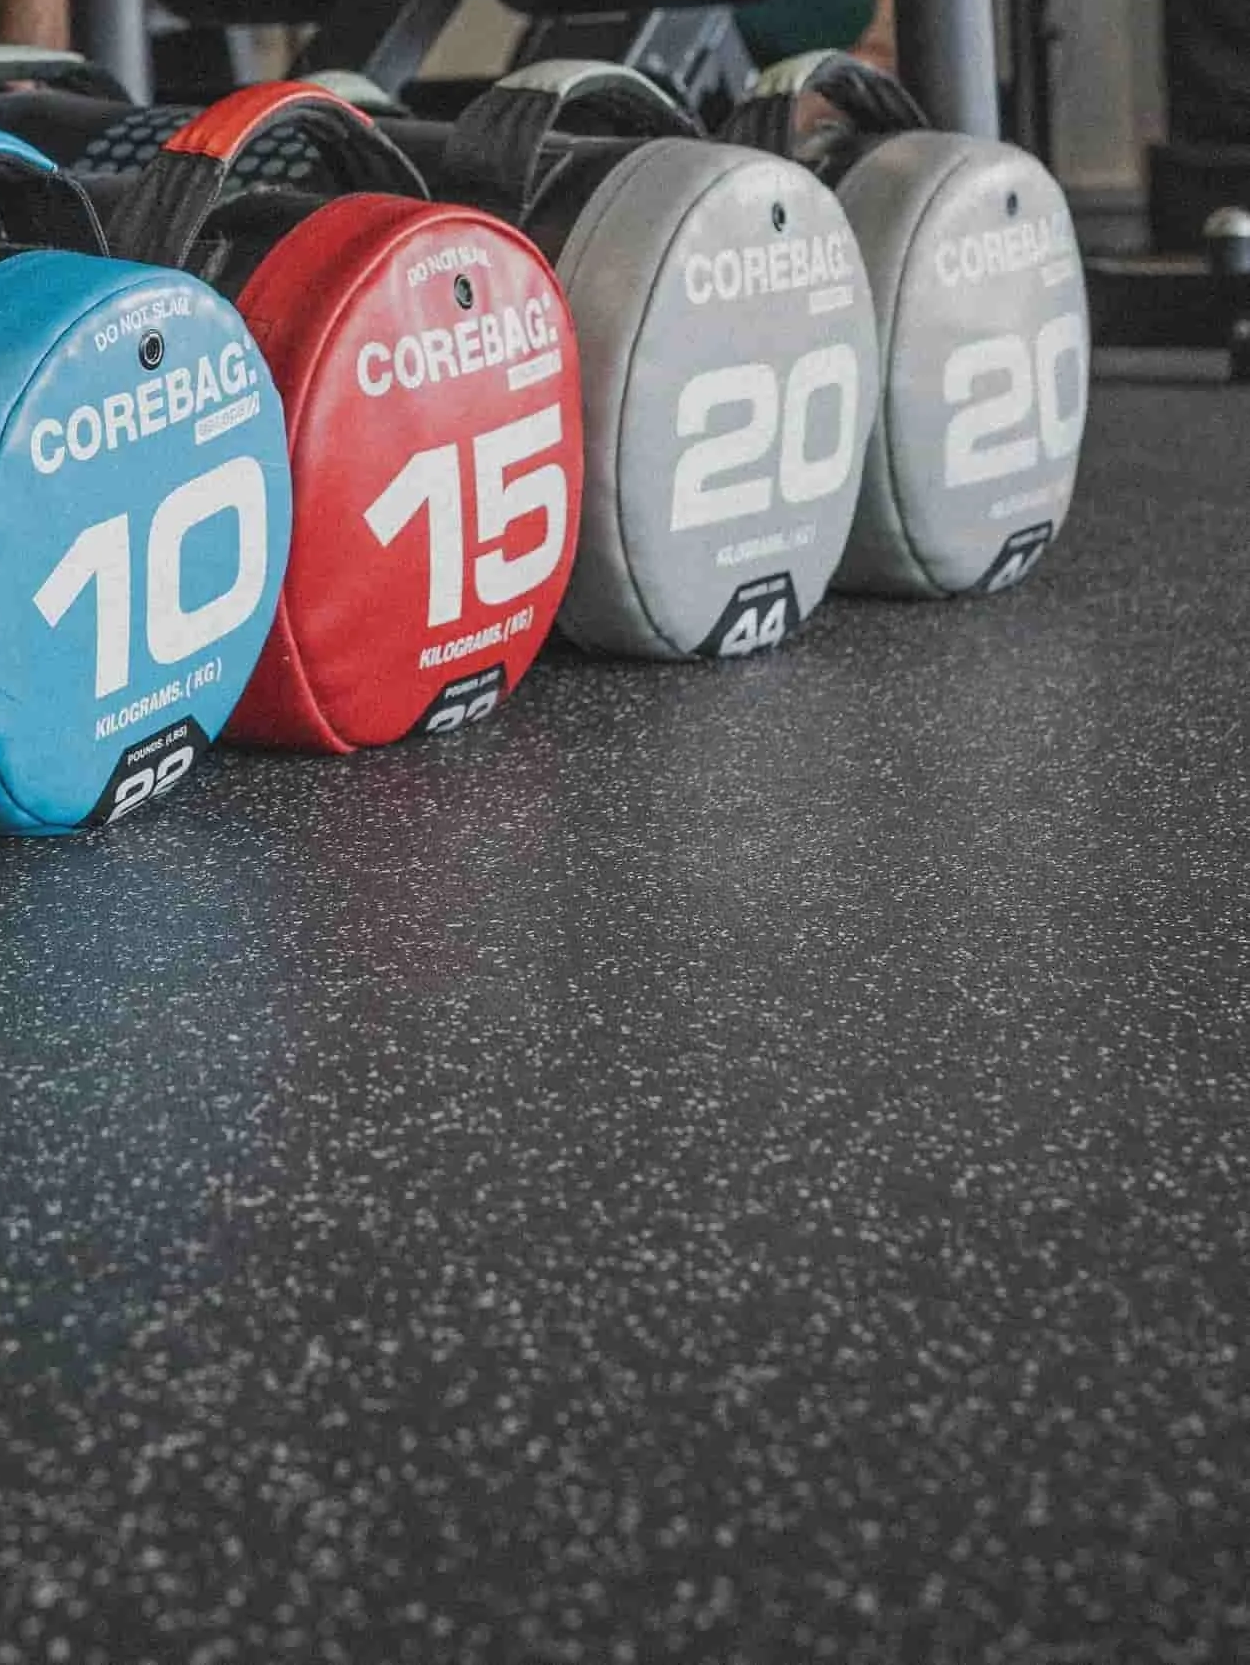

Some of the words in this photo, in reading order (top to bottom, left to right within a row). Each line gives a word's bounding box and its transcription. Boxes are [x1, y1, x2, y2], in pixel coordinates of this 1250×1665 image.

[93, 324, 119, 352] DO
[120, 306, 149, 335] NOT
[943, 313, 1086, 488] 20
[362, 402, 568, 628] 15
[670, 343, 858, 532] 20
[32, 455, 268, 699] 10
[718, 598, 787, 657] 44
